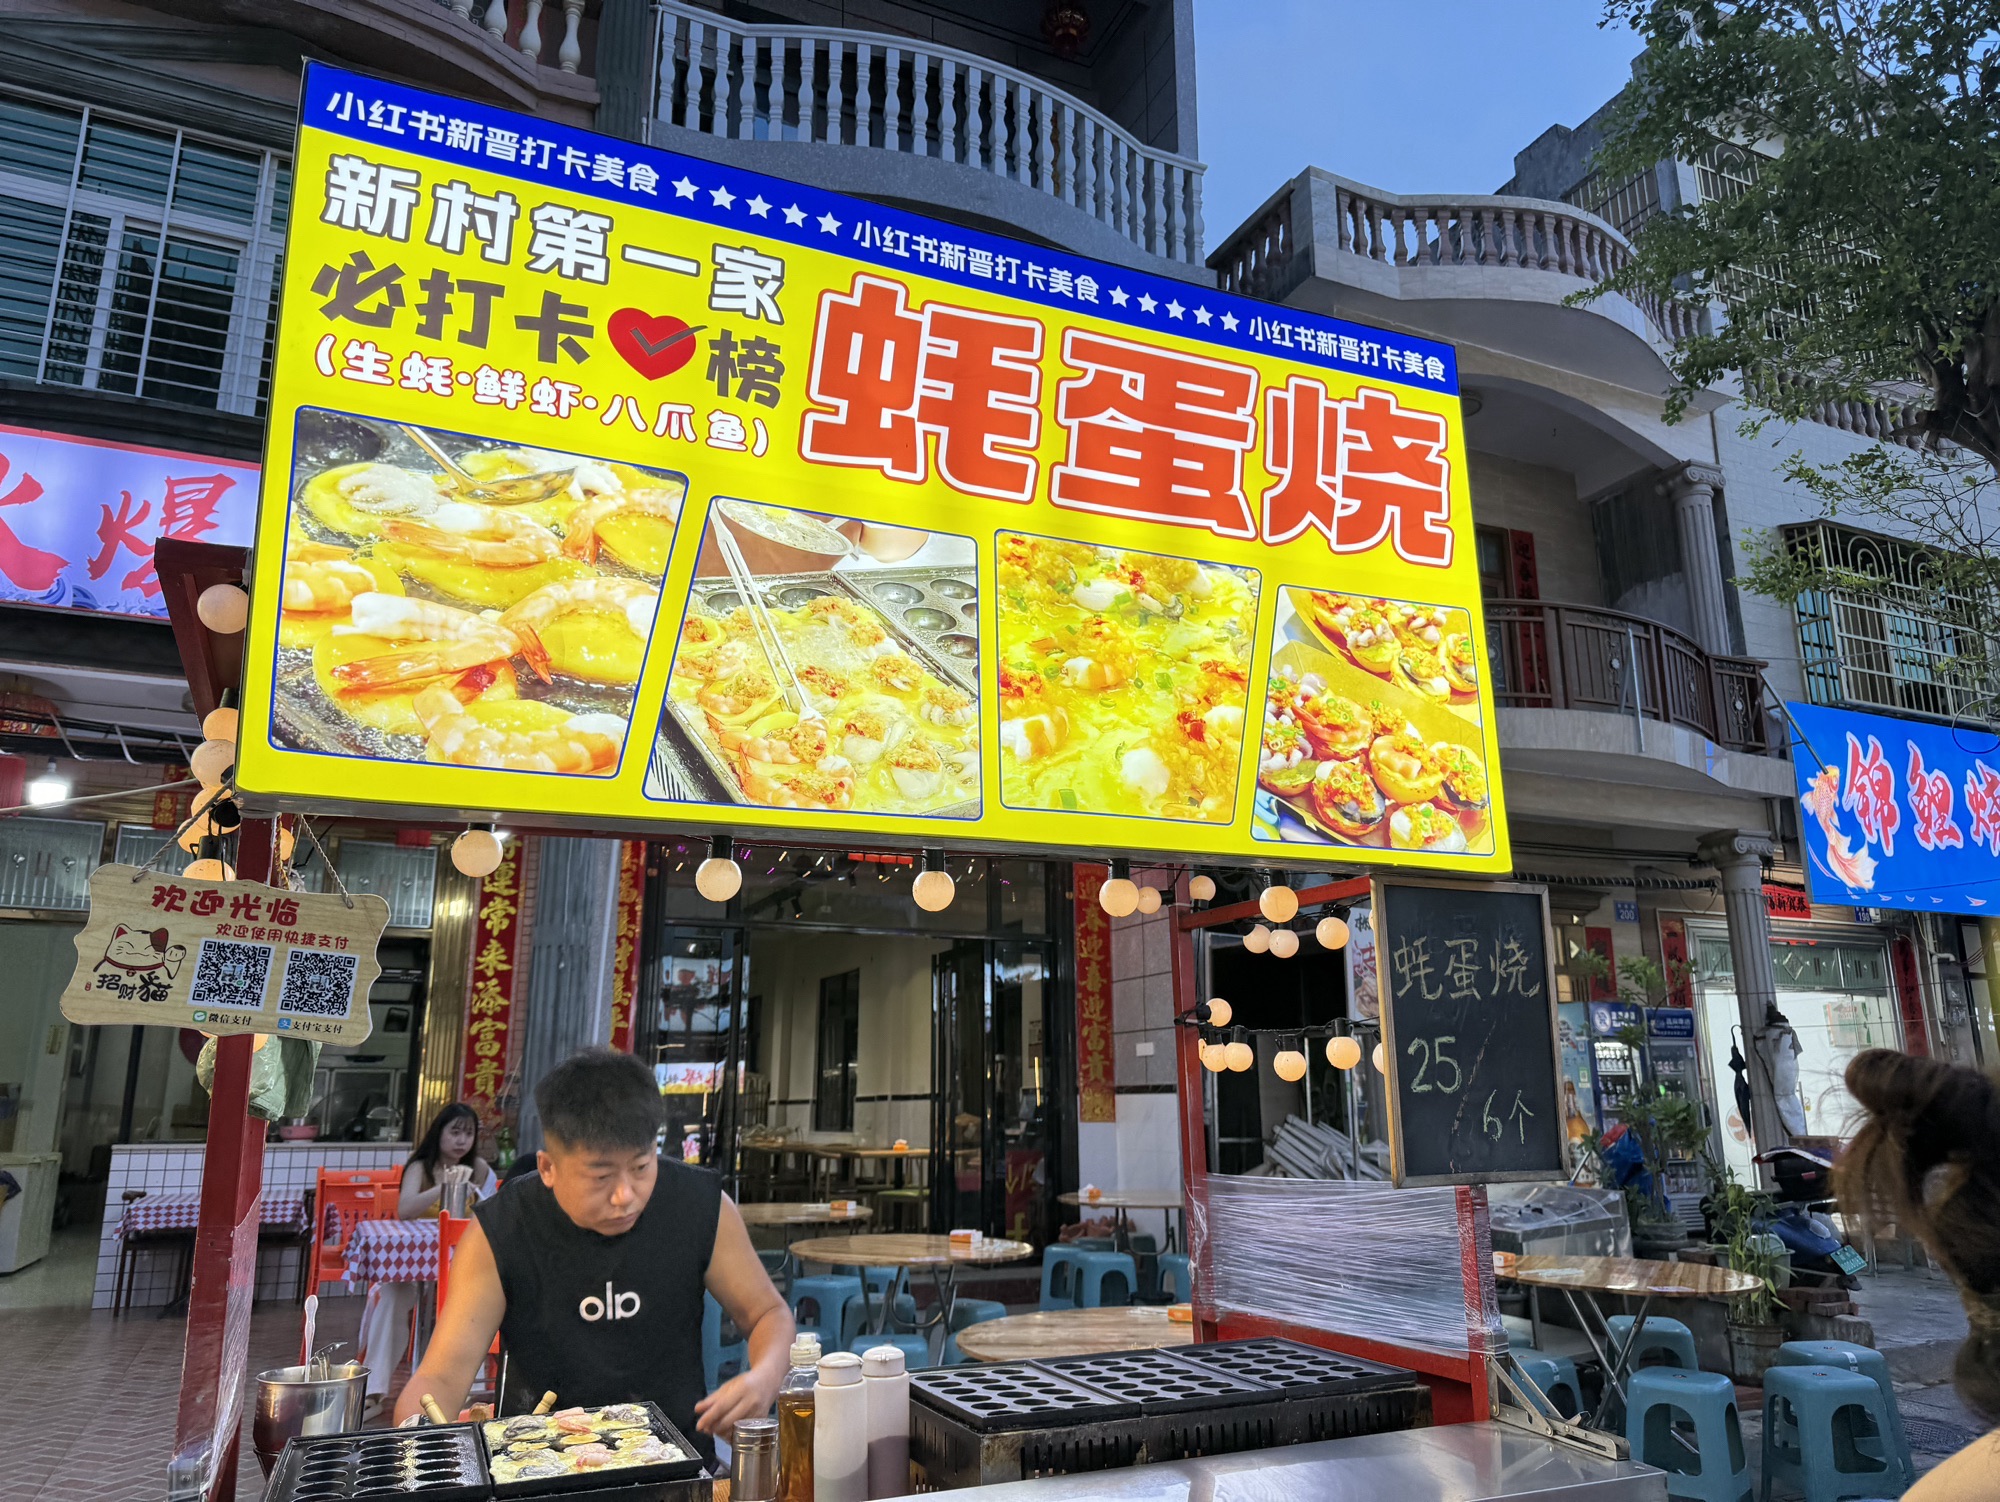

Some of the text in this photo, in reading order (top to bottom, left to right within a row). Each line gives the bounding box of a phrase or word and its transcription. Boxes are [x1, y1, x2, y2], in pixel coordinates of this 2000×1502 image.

[325, 91, 660, 197] 小红书新晋打卡美食
[320, 154, 785, 326] 新村第一家
[852, 219, 1100, 304] 小红书新晋打卡美食
[311, 250, 786, 409] 必打卡 榜
[1247, 316, 1447, 382] 小红书新晋打卡美食
[799, 271, 1455, 568] 蚝蛋烧
[151, 884, 301, 927] 欢迎光临
[216, 924, 350, 950] 欢迎使用快捷支付
[1619, 909, 1635, 920] 200
[1393, 935, 1541, 1000] 蚝蛋烧
[208, 1012, 252, 1026] 微信支付
[292, 1020, 343, 1034] 支付宝支付
